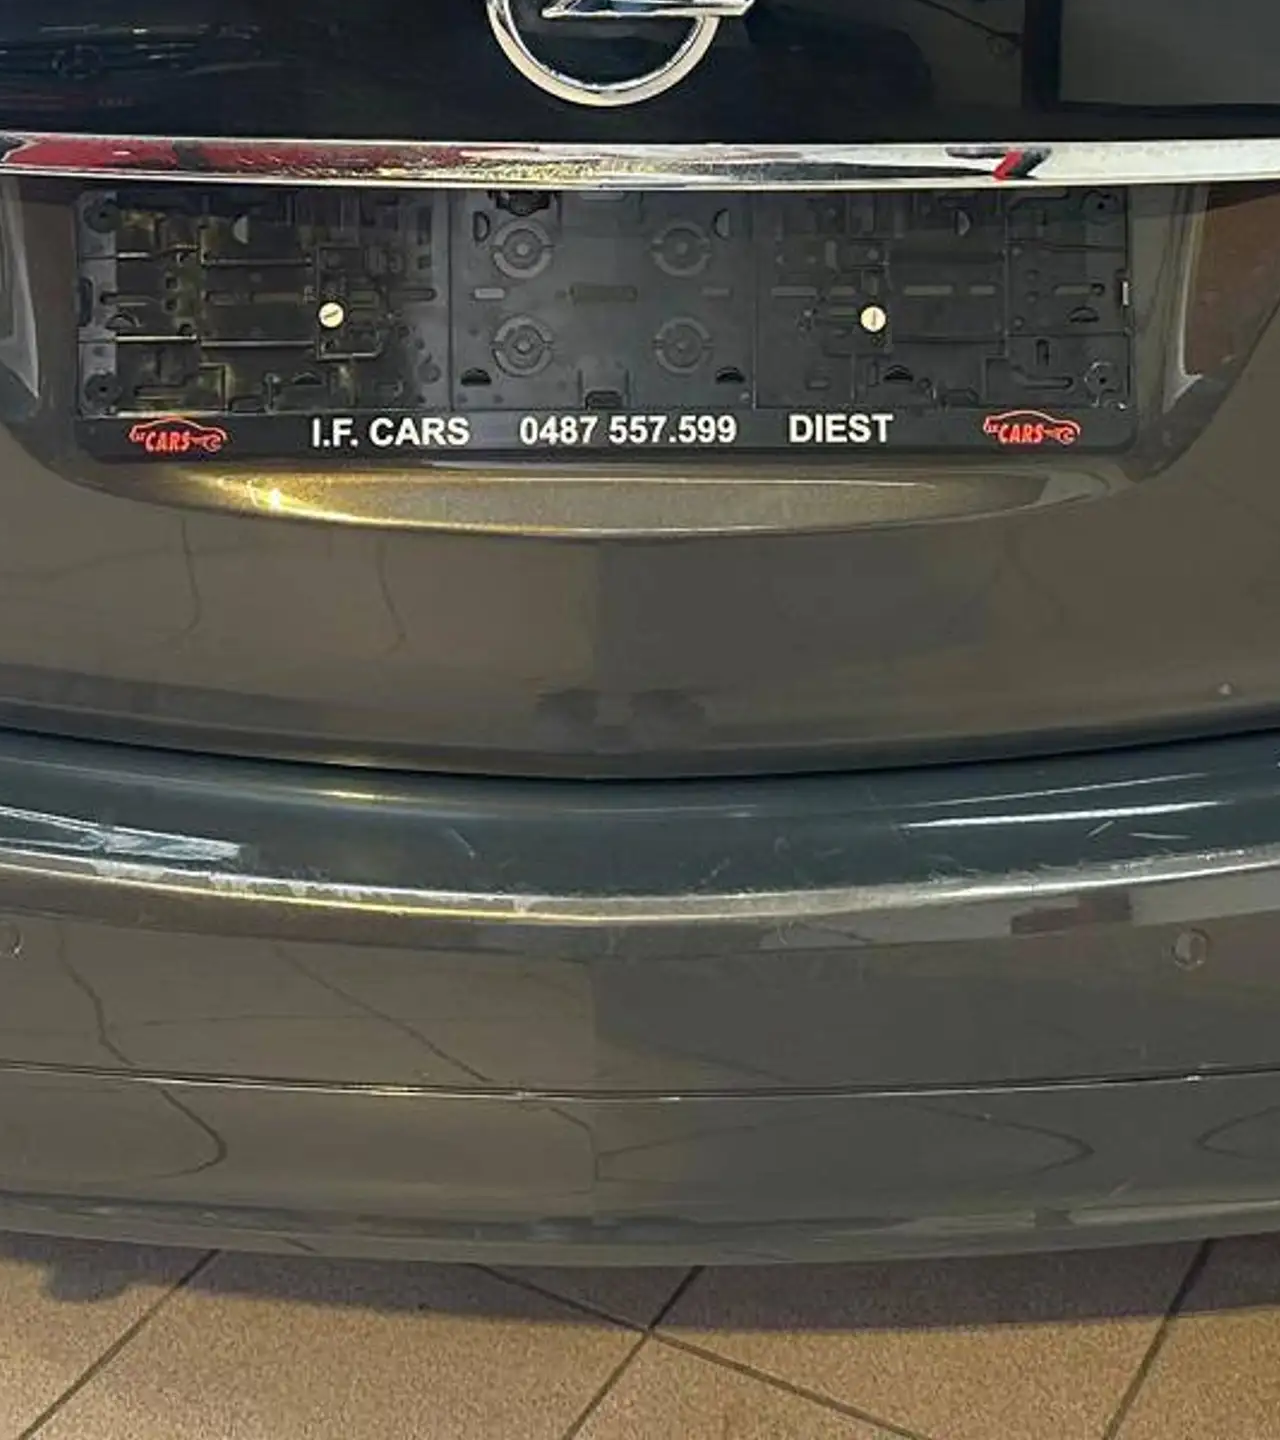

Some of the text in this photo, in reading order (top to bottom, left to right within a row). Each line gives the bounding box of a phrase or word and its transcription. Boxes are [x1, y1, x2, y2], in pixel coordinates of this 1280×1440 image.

[313, 412, 894, 447] I.F. CARS 0487 557.599 DIEST
[999, 423, 1044, 444] CARS
[145, 431, 190, 452] CARS
